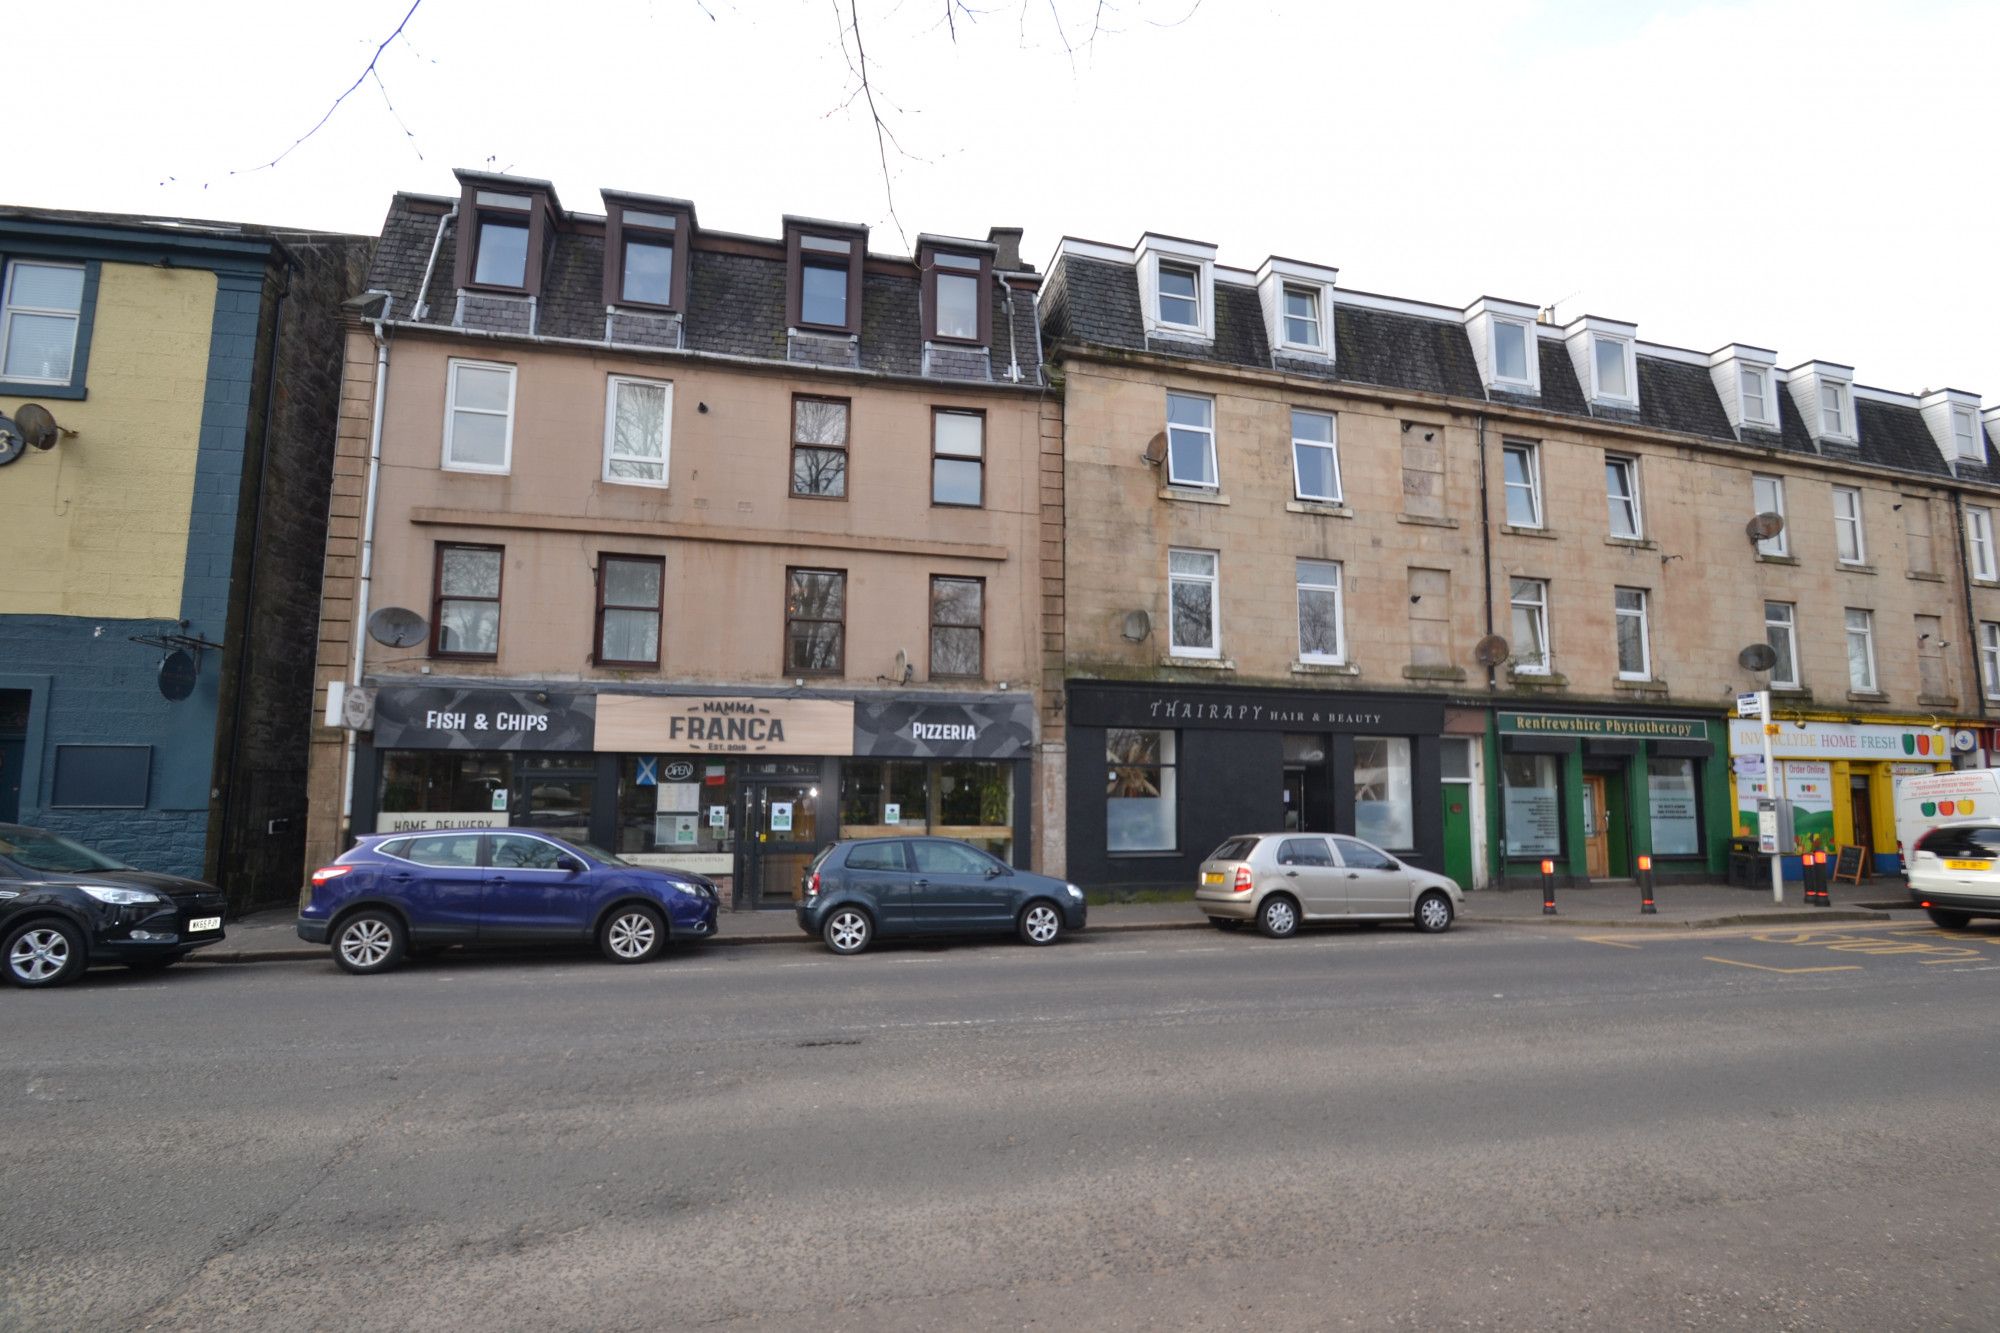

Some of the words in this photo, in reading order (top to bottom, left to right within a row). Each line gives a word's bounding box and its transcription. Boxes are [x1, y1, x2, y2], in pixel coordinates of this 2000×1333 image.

[703, 702, 755, 716] MAMMA
[1150, 699, 1262, 720] THAIRAPY
[1270, 711, 1304, 721] HAIR
[1312, 712, 1320, 722] &
[1328, 713, 1380, 724] BEAUTY
[426, 710, 466, 730] FISH
[474, 713, 489, 730] &
[496, 712, 548, 731] CHIPS
[669, 716, 785, 742] FRANCA
[1516, 716, 1601, 731] Renfrewshire
[1606, 719, 1692, 736] Physiotherapy
[912, 722, 976, 740] PIZZERIA
[1740, 731, 1816, 747] INVRCLYDE
[1821, 734, 1857, 748] HOME
[1861, 735, 1897, 749] FRESH
[666, 763, 692, 777] OPEN
[1789, 764, 1805, 774] Order
[1806, 765, 1825, 774] Online
[394, 820, 427, 832] HOME
[436, 820, 493, 829] DELIVERY
